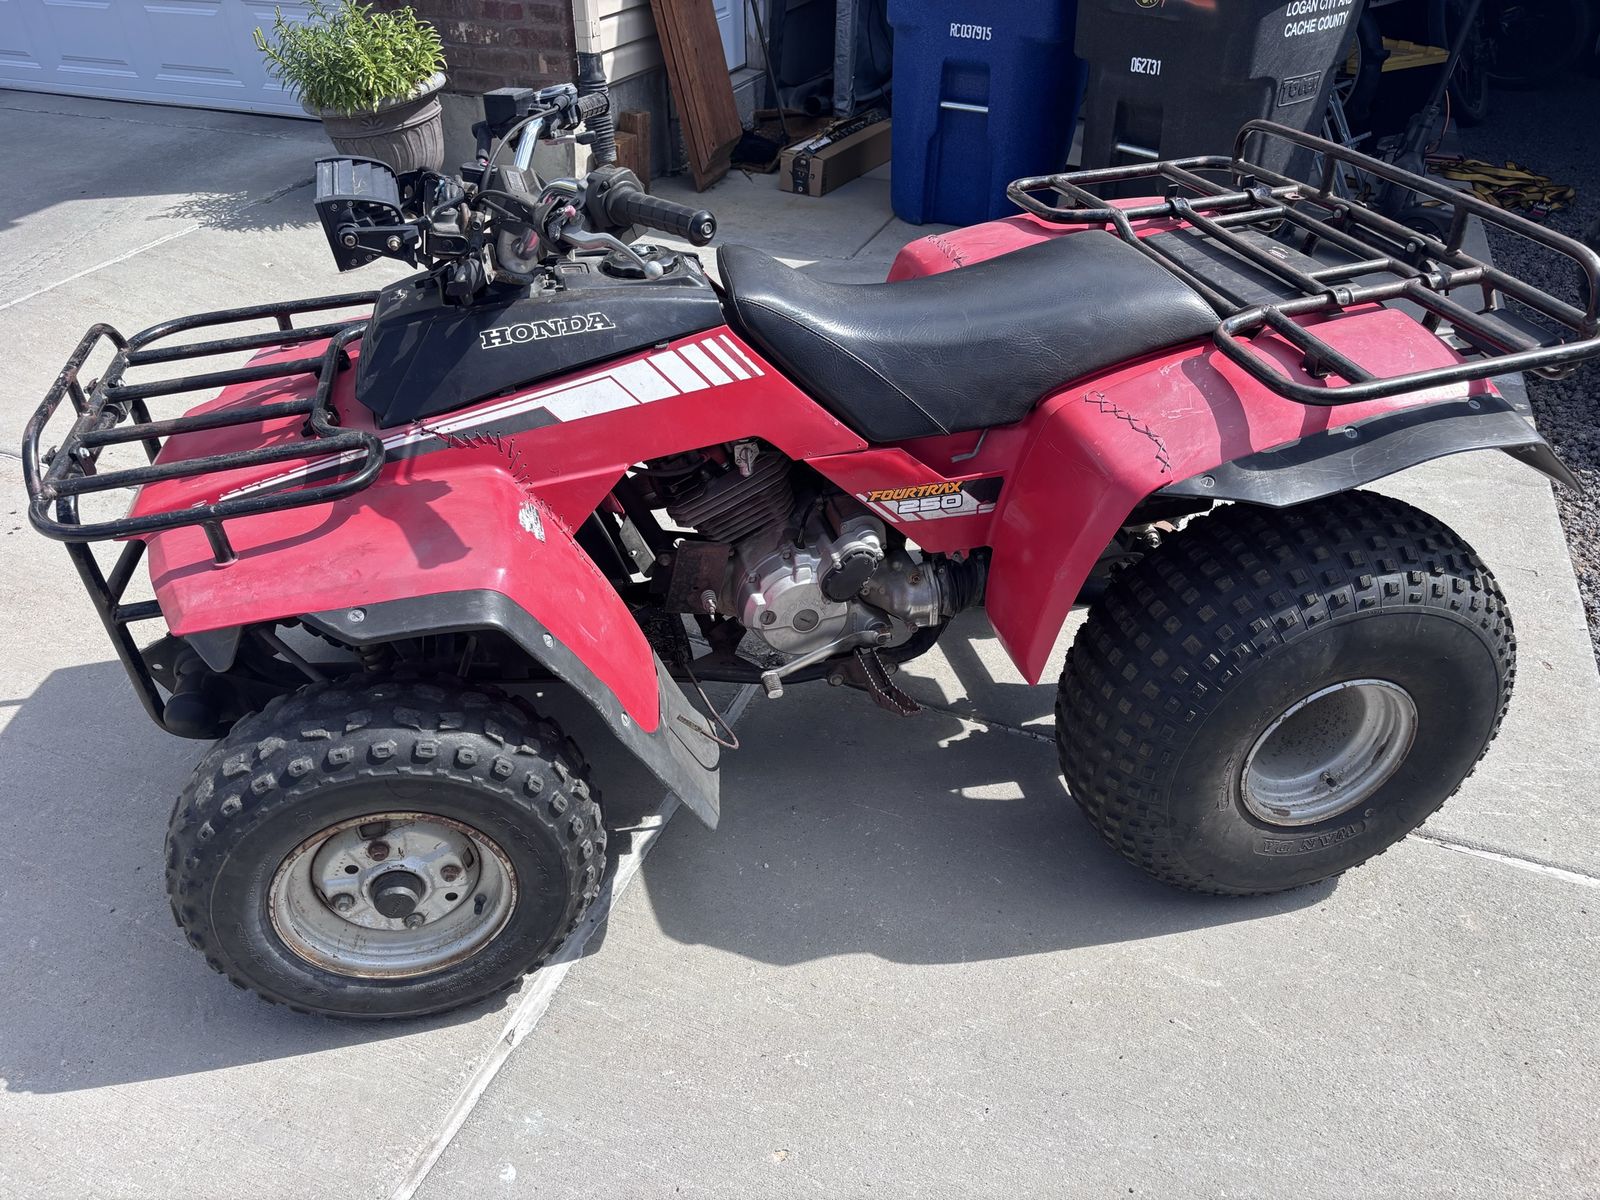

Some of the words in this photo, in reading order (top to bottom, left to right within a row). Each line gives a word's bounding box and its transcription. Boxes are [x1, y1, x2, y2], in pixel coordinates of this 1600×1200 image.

[1286, 0, 1318, 16] LOGAN
[949, 22, 992, 41] RC037915
[1284, 18, 1317, 37] CACHE
[1318, 10, 1349, 30] COUNTY
[1130, 57, 1162, 75] 062731
[479, 311, 616, 349] HONDA
[868, 480, 964, 502] FOURTRAX
[897, 494, 963, 514] 250
